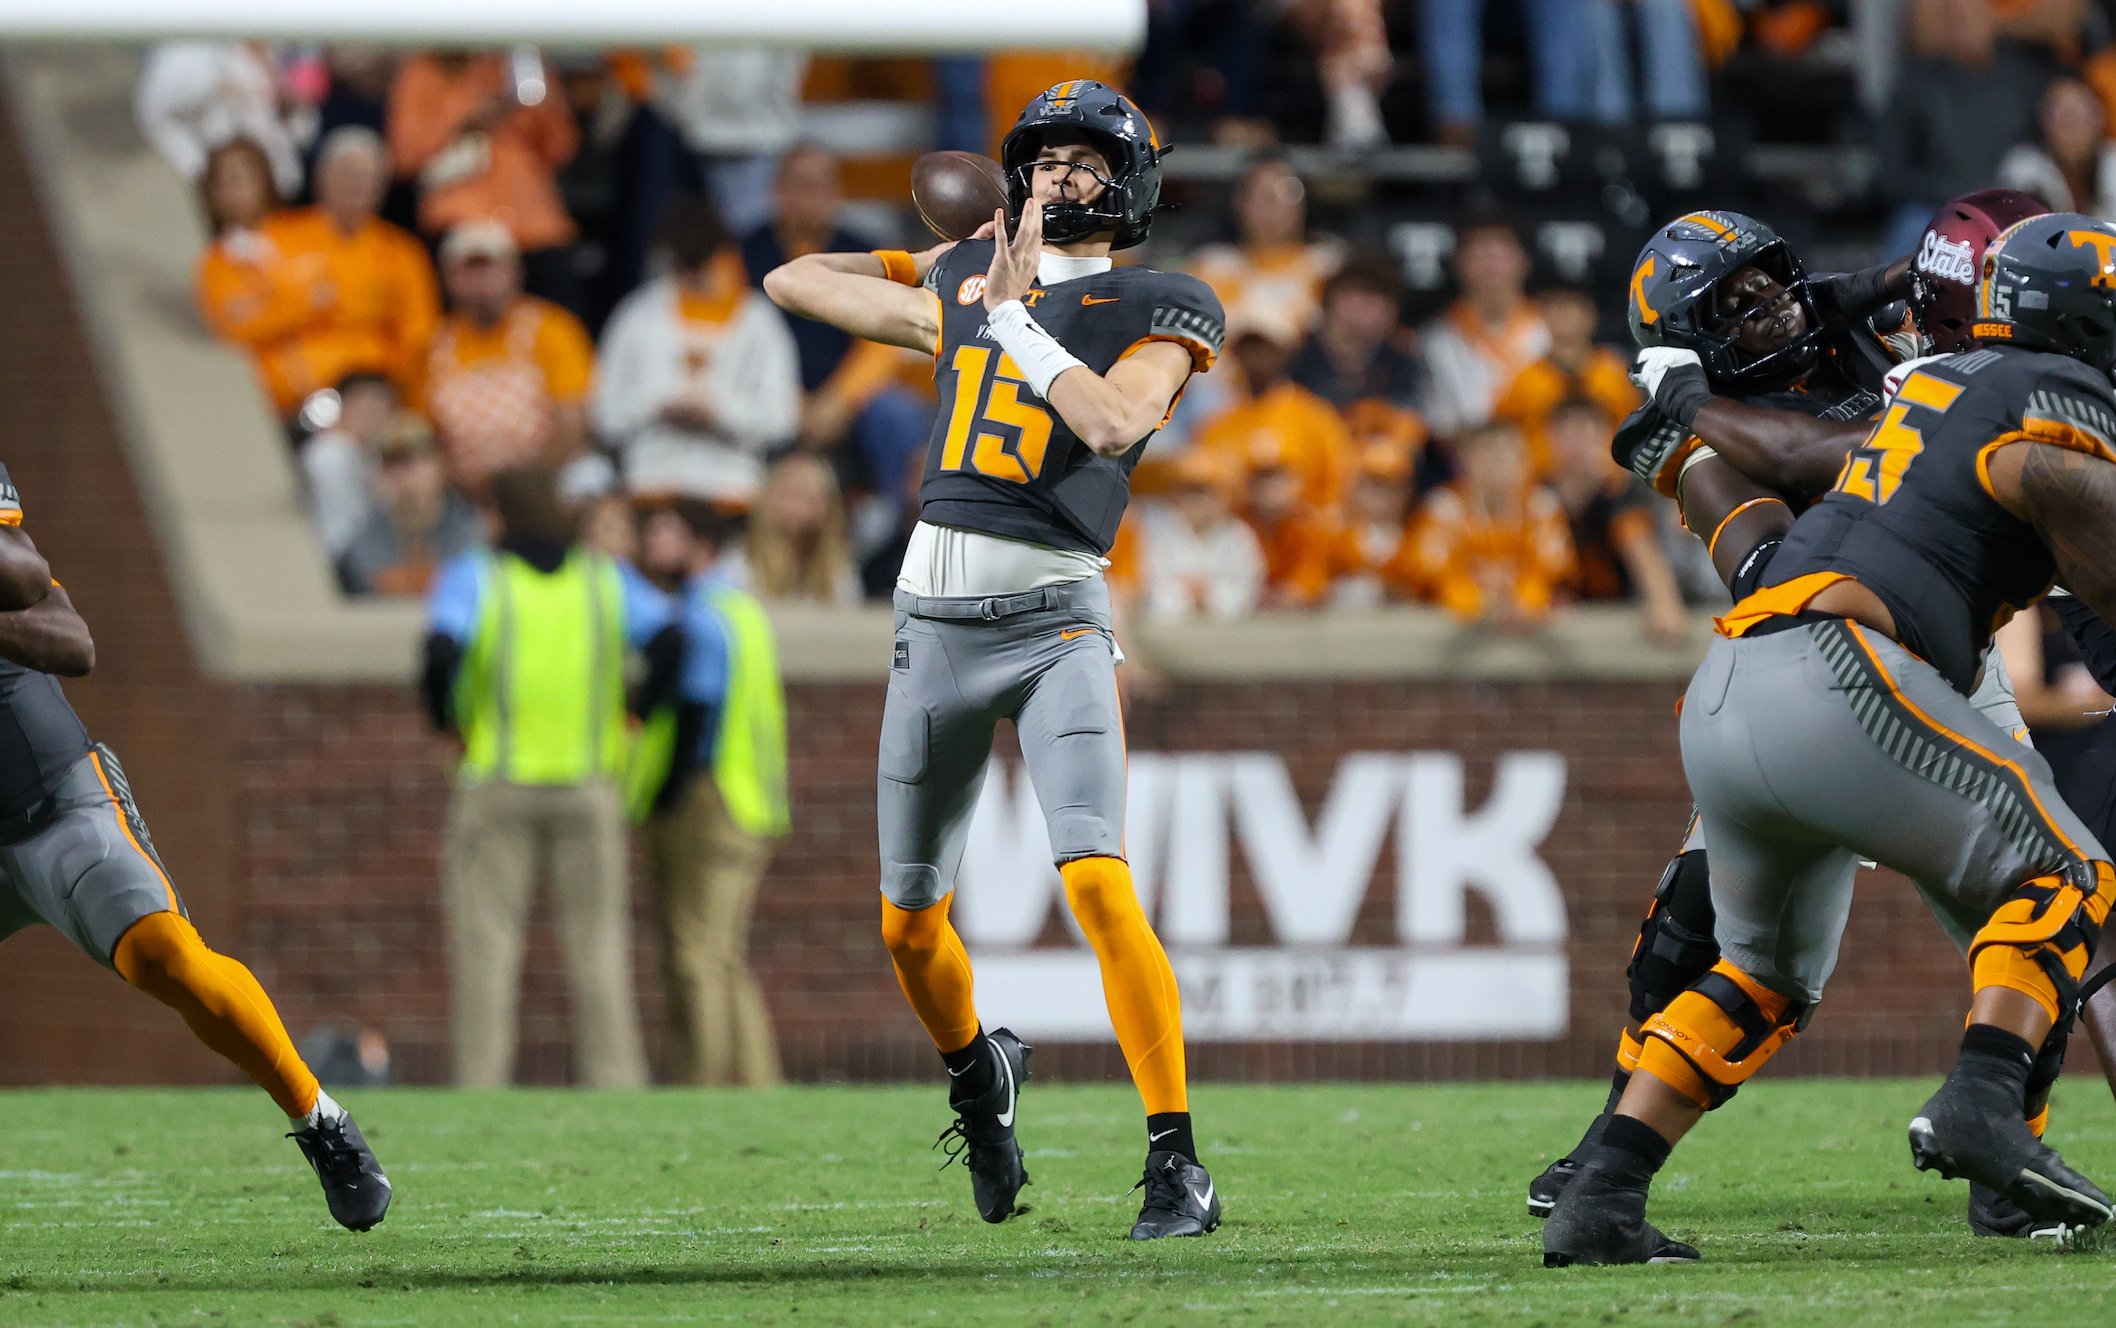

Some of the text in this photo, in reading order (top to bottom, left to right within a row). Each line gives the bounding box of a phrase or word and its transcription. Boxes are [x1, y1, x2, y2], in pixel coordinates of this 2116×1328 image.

[1918, 229, 1976, 285] State
[2068, 230, 2116, 289] T
[959, 276, 989, 303] SEC
[1024, 288, 1047, 308] T
[940, 345, 1053, 484] 15
[1832, 369, 1967, 507] 5
[956, 751, 1568, 944] WIVK
